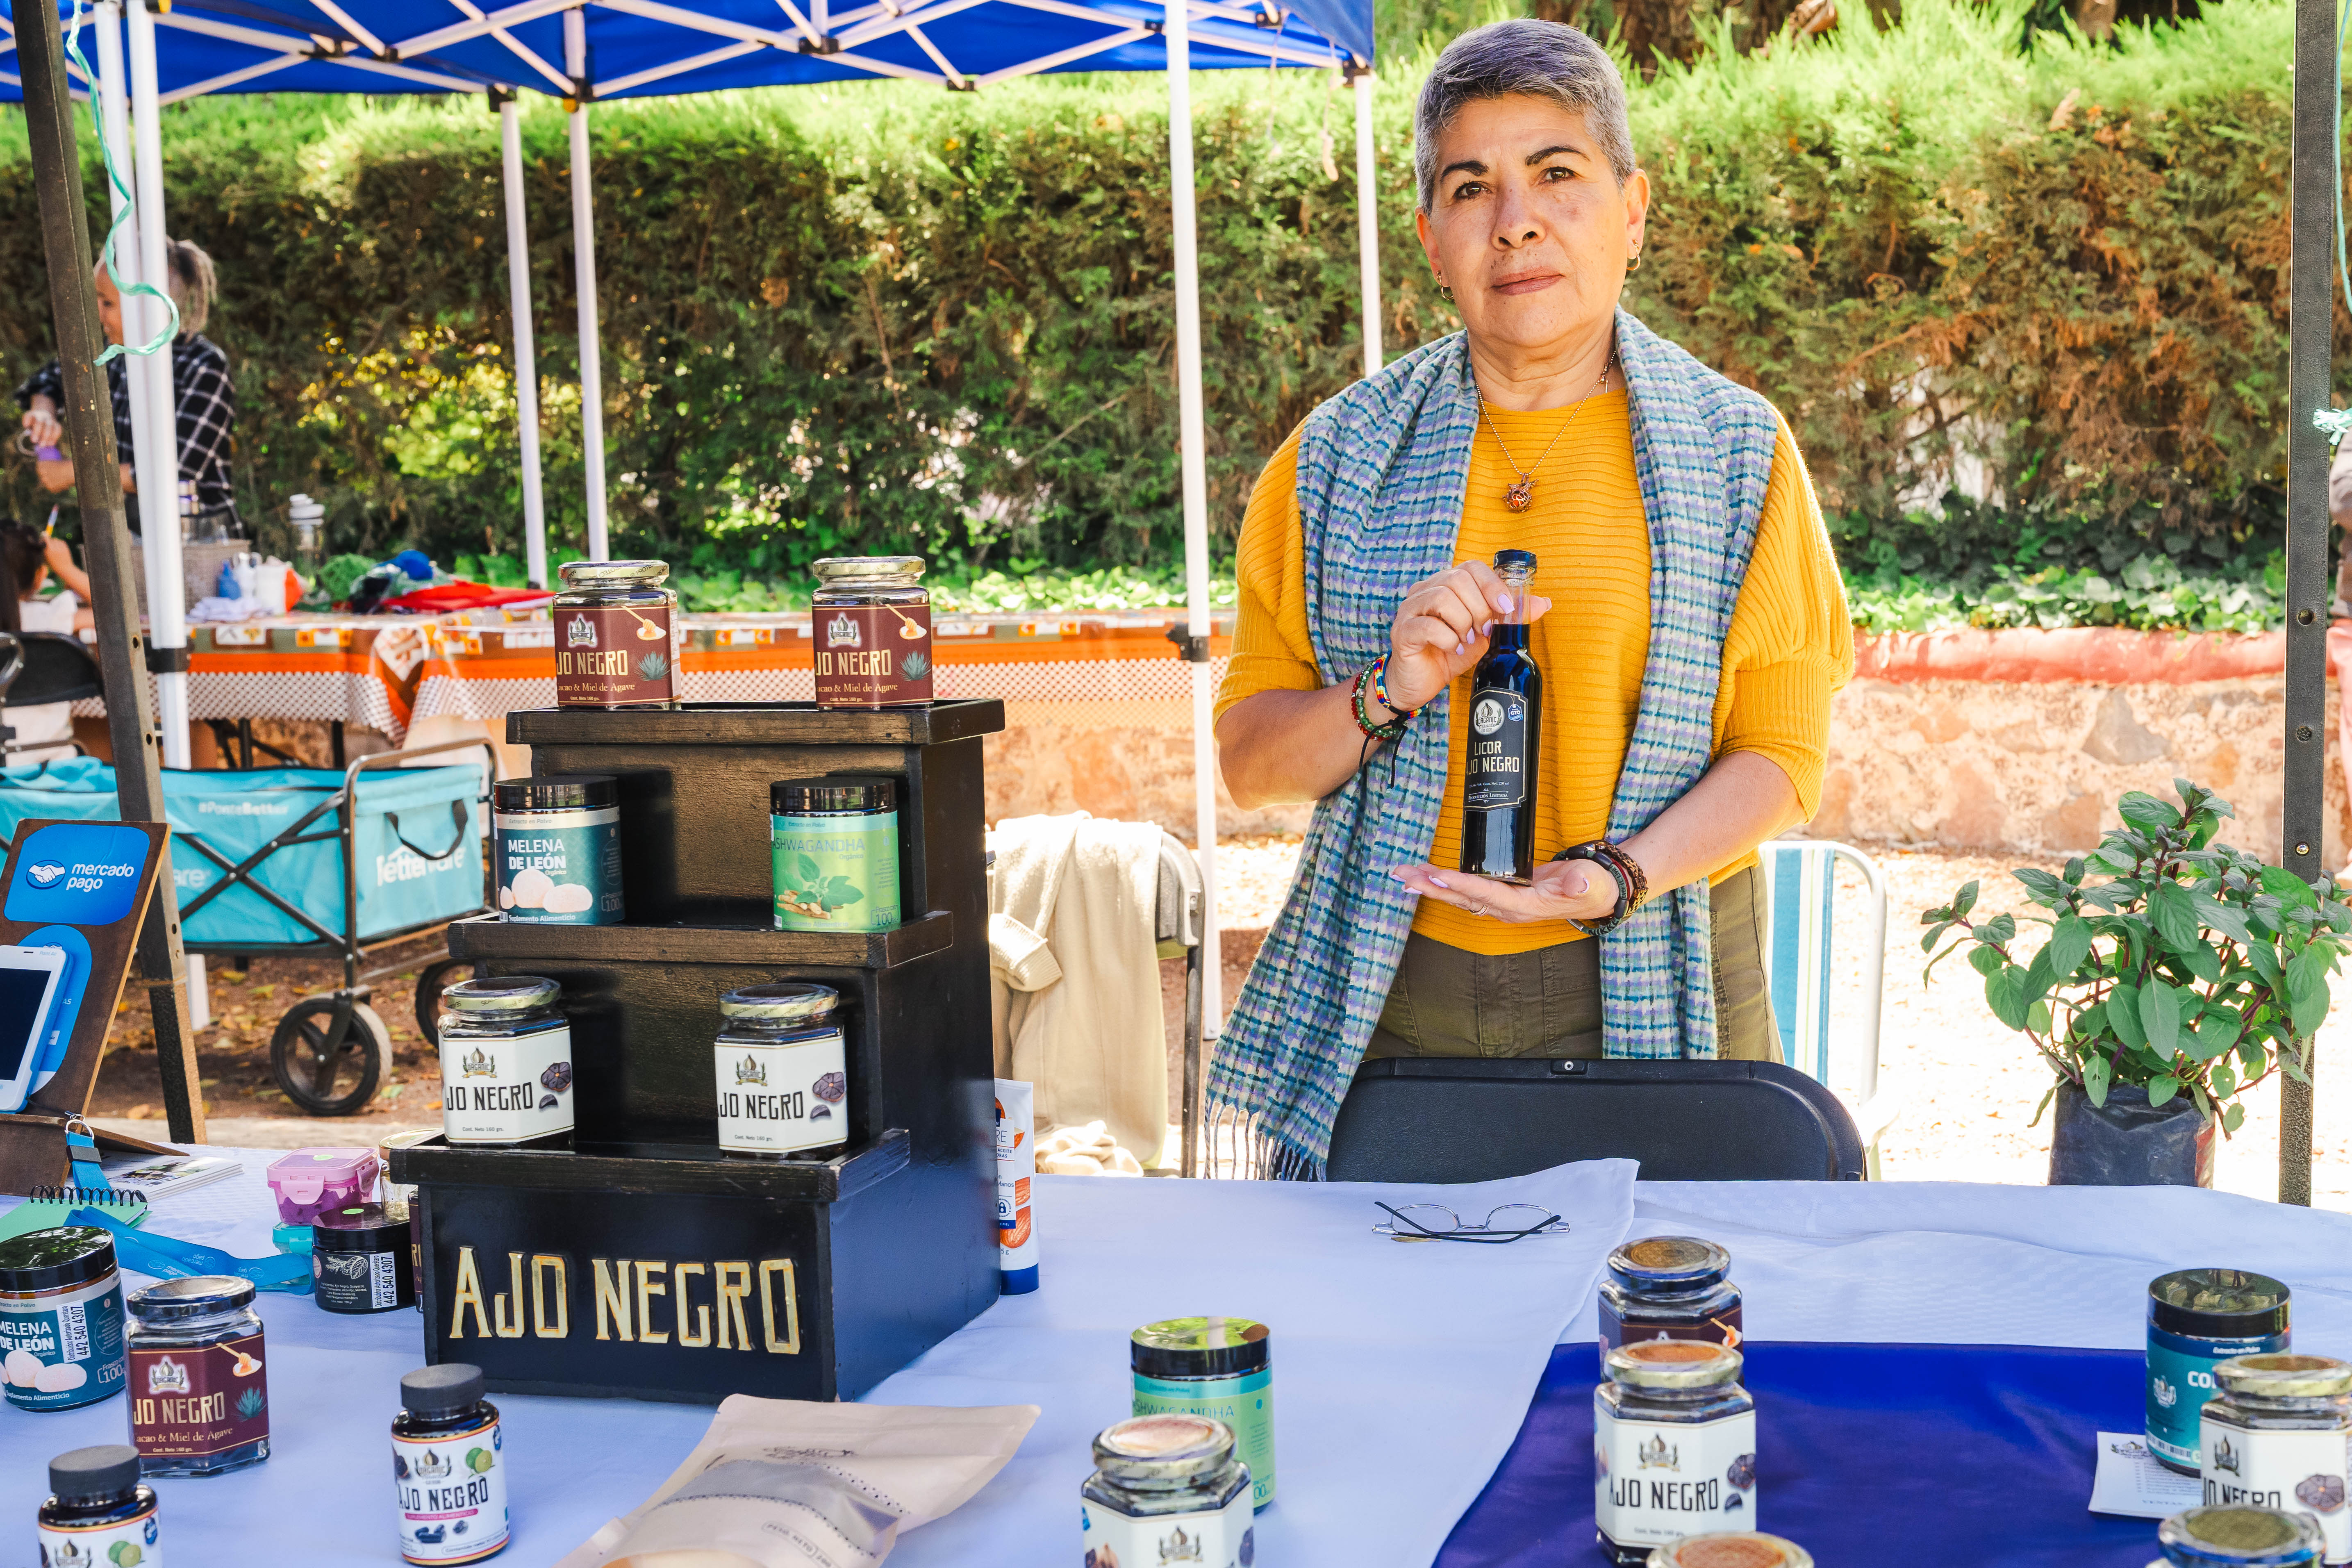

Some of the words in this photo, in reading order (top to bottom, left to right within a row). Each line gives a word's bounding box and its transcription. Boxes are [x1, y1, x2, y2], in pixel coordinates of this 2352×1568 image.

[577, 650, 628, 676] NEGRO
[837, 649, 892, 676] NEGRO
[582, 683, 598, 691] Miel
[599, 683, 608, 691] de
[610, 683, 635, 692] Agave
[844, 683, 861, 692] Miel
[863, 683, 872, 692] de
[875, 683, 898, 693] Agave
[1474, 741, 1502, 756] LICOR
[1466, 759, 1478, 776] AJO
[1483, 756, 1519, 773] NEGRO
[508, 839, 565, 853] MELENA
[773, 838, 865, 852] ASHWAGANDHA
[509, 856, 525, 869] DE
[527, 852, 566, 869] LEÓN
[71, 863, 134, 877] mercado
[66, 877, 103, 892] pago
[876, 912, 892, 926] 100
[474, 1082, 533, 1111] NEGRO
[746, 1091, 803, 1120] NEGRO
[181, 1257, 203, 1265] mercado
[381, 1256, 393, 1274] 4307
[166, 1265, 191, 1277] mercado
[382, 1276, 394, 1289] 540
[382, 1290, 395, 1304] 442
[449, 1245, 568, 1338] AJO
[591, 1258, 801, 1354] NEGRO
[61, 1306, 70, 1322] Querétaro
[71, 1306, 84, 1323] 4307
[64, 1323, 73, 1340] Autorizado
[74, 1326, 87, 1340] 540
[0, 1336, 14, 1350] DE
[14, 1335, 55, 1352] LEÓN
[66, 1341, 75, 1360] Distribuidor
[76, 1341, 89, 1355] 442
[102, 1359, 118, 1371] Frasco
[103, 1364, 122, 1383] 100
[6, 1390, 32, 1401] Suplemento
[33, 1393, 70, 1401] Alimenticio
[161, 1391, 225, 1424] NEGRO
[158, 1434, 166, 1442] &
[170, 1432, 190, 1442] Miel
[193, 1432, 204, 1442] de
[207, 1427, 233, 1440] Agave
[398, 1484, 420, 1511] AJO
[428, 1477, 488, 1511] NEGRO
[1651, 1478, 1718, 1511] NEGRO
